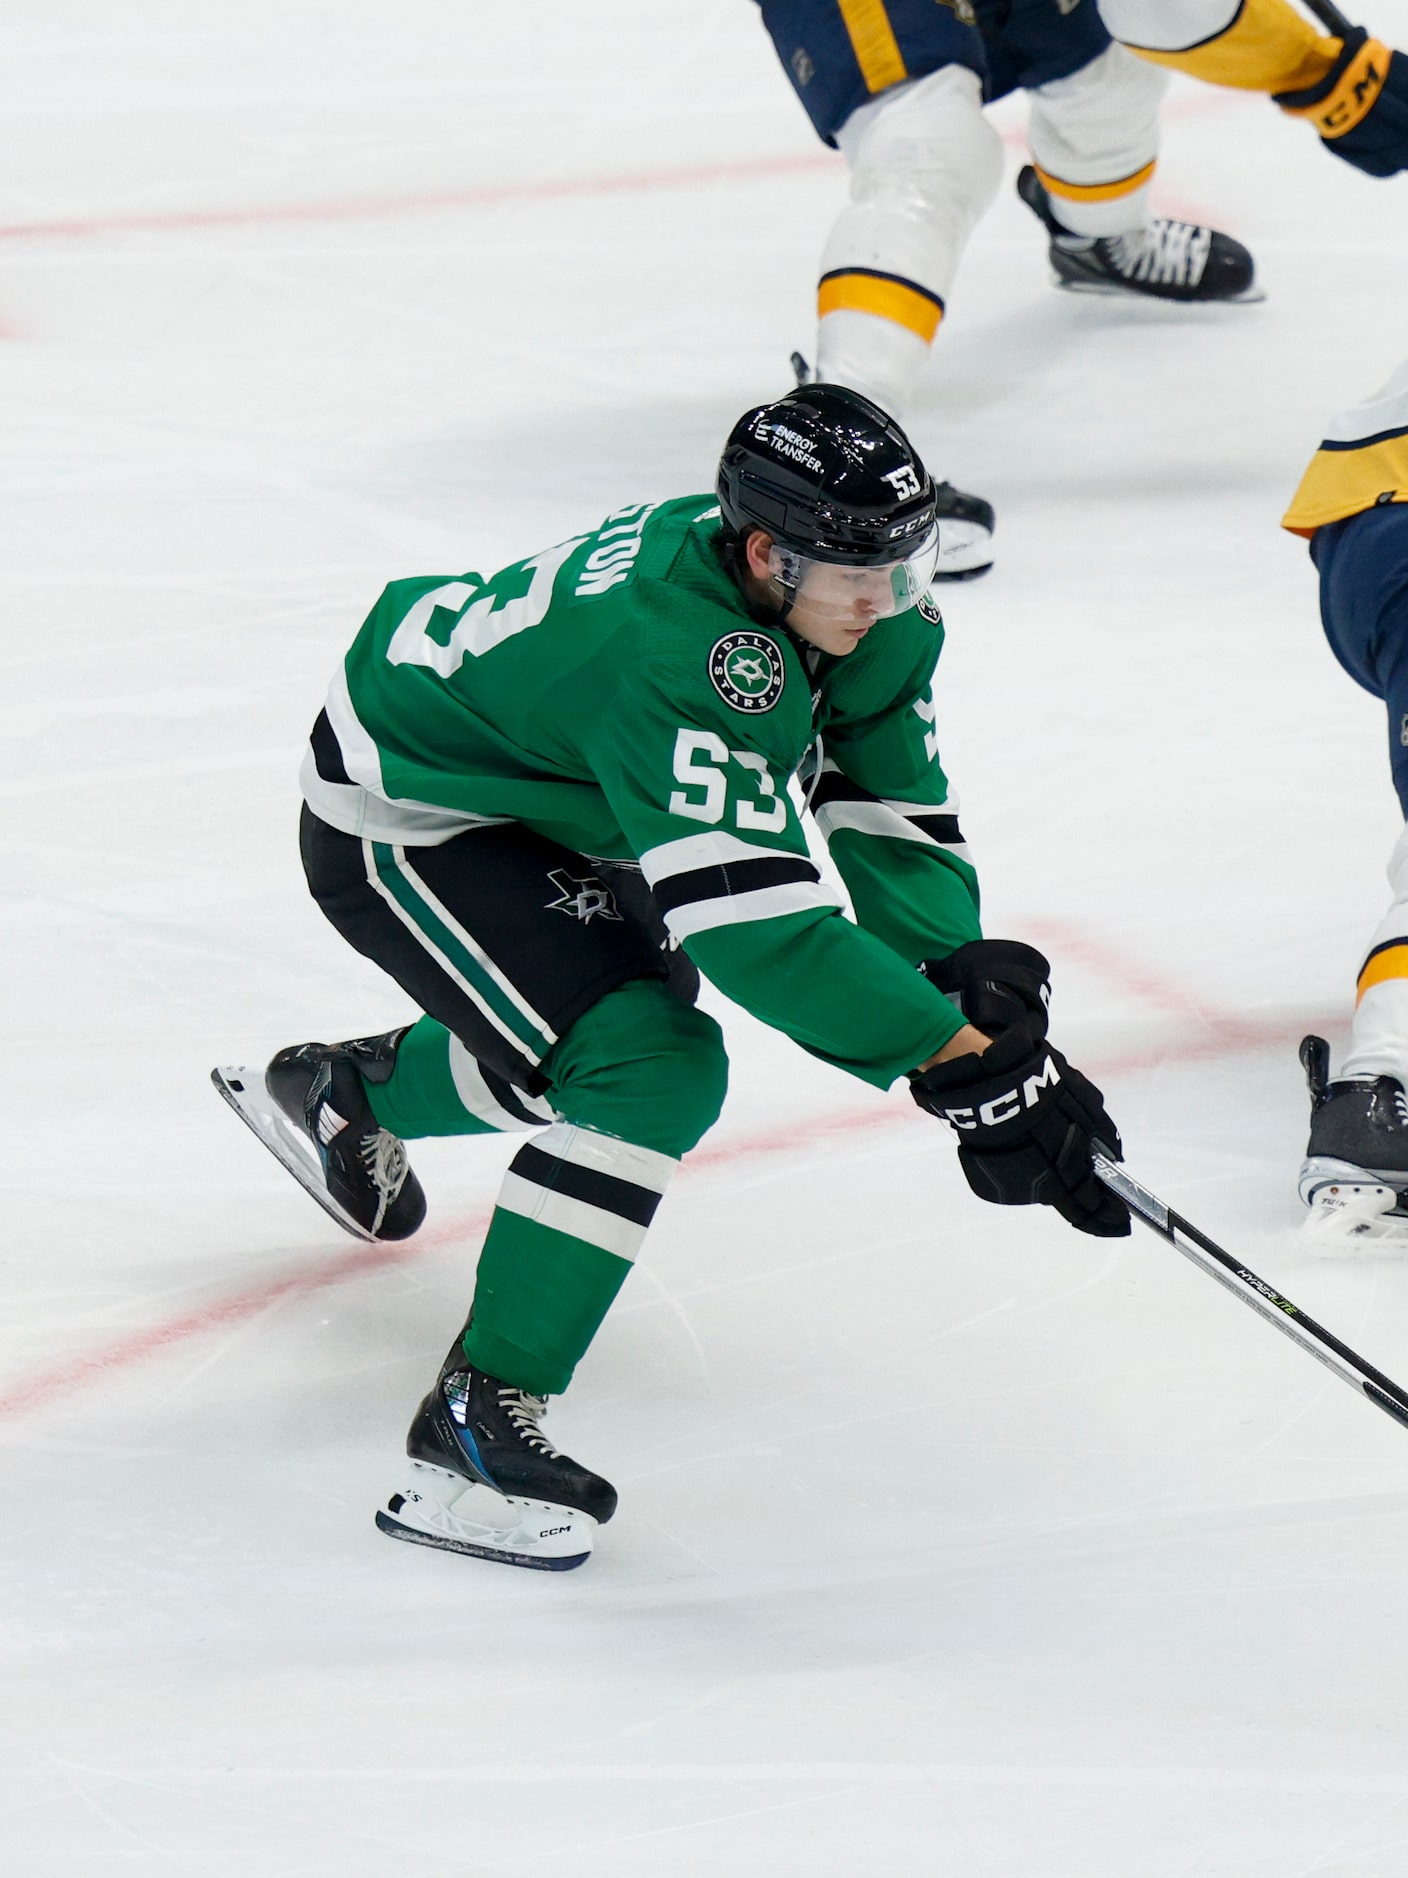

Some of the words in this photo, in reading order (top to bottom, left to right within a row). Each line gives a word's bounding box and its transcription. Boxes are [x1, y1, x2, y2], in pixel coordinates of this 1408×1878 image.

[775, 425, 818, 453] ENERGY
[879, 465, 921, 501] 53
[888, 510, 931, 539] CCM
[722, 635, 781, 686] DALLAS
[714, 665, 768, 708] STARS
[669, 727, 787, 834] 53
[944, 1054, 1062, 1130] CCM
[1236, 1269, 1298, 1316] HYPERLITE
[539, 1525, 572, 1538] CCM
